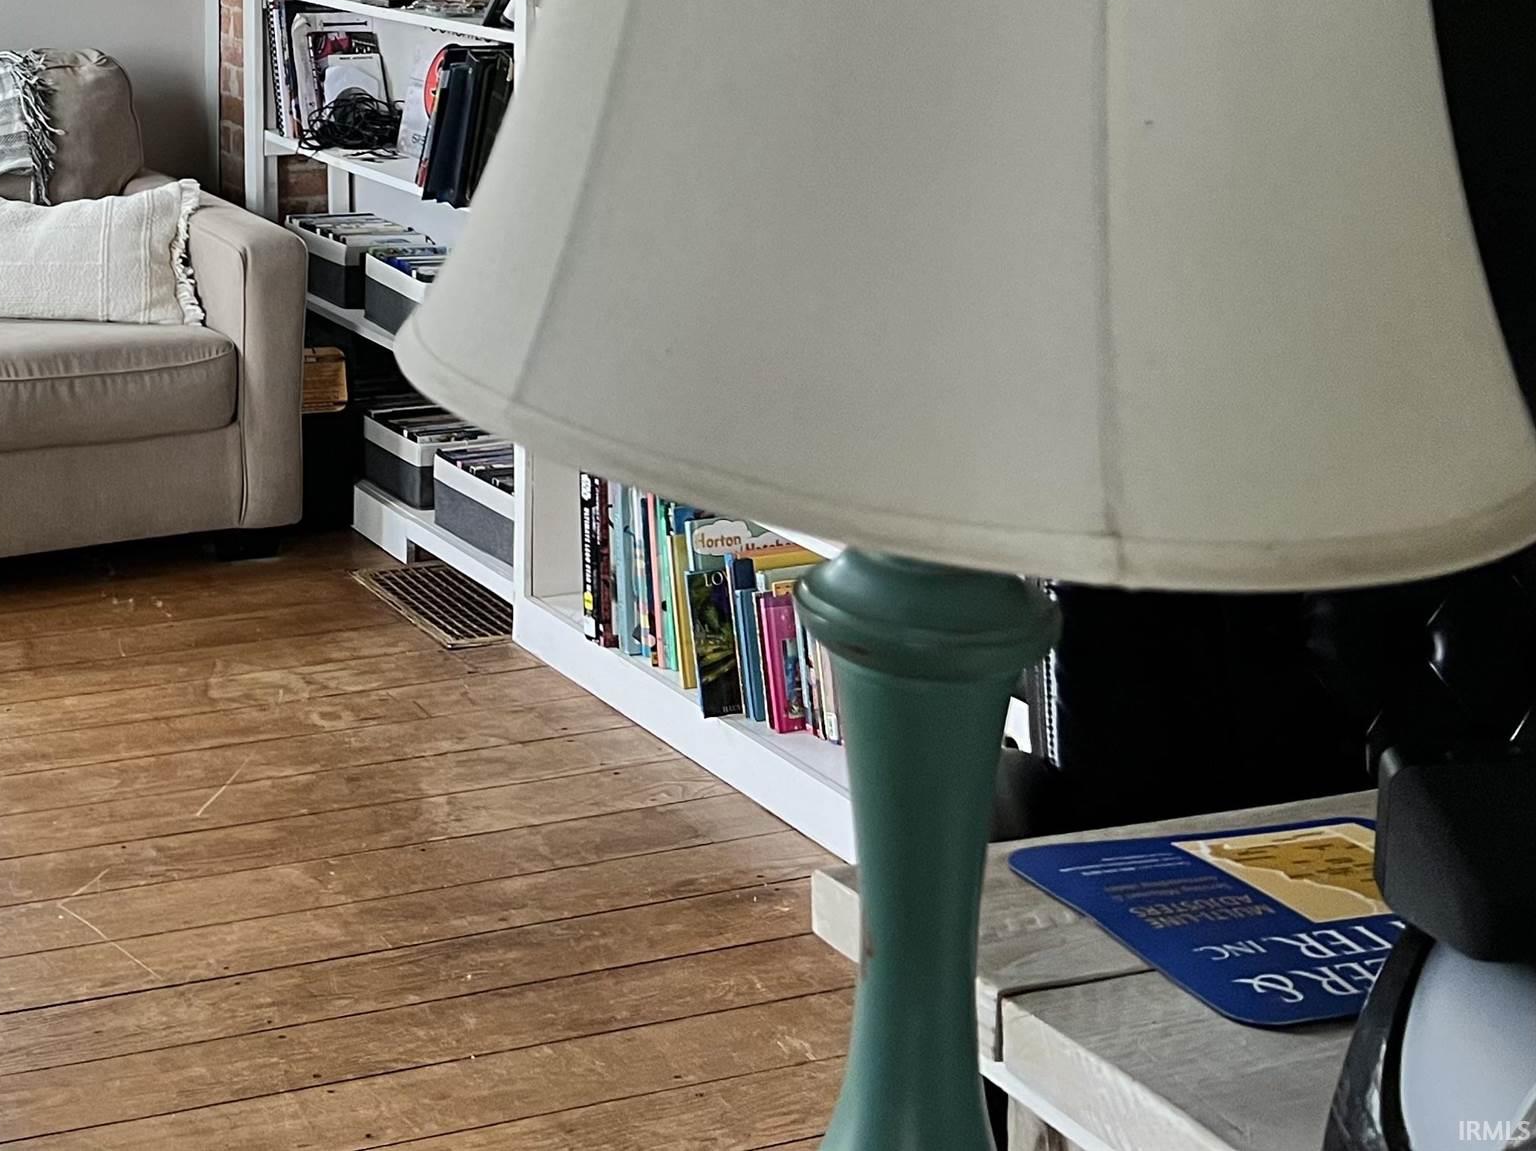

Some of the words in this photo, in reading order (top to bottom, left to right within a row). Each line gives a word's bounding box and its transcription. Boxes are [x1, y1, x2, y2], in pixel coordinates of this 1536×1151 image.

[583, 507, 591, 543] ULTIMATE
[697, 534, 742, 549] Horton
[1129, 894, 1252, 916] ADJUSTERS
[1145, 904, 1276, 929] MULTI-LINE
[1231, 973, 1304, 1003] &
